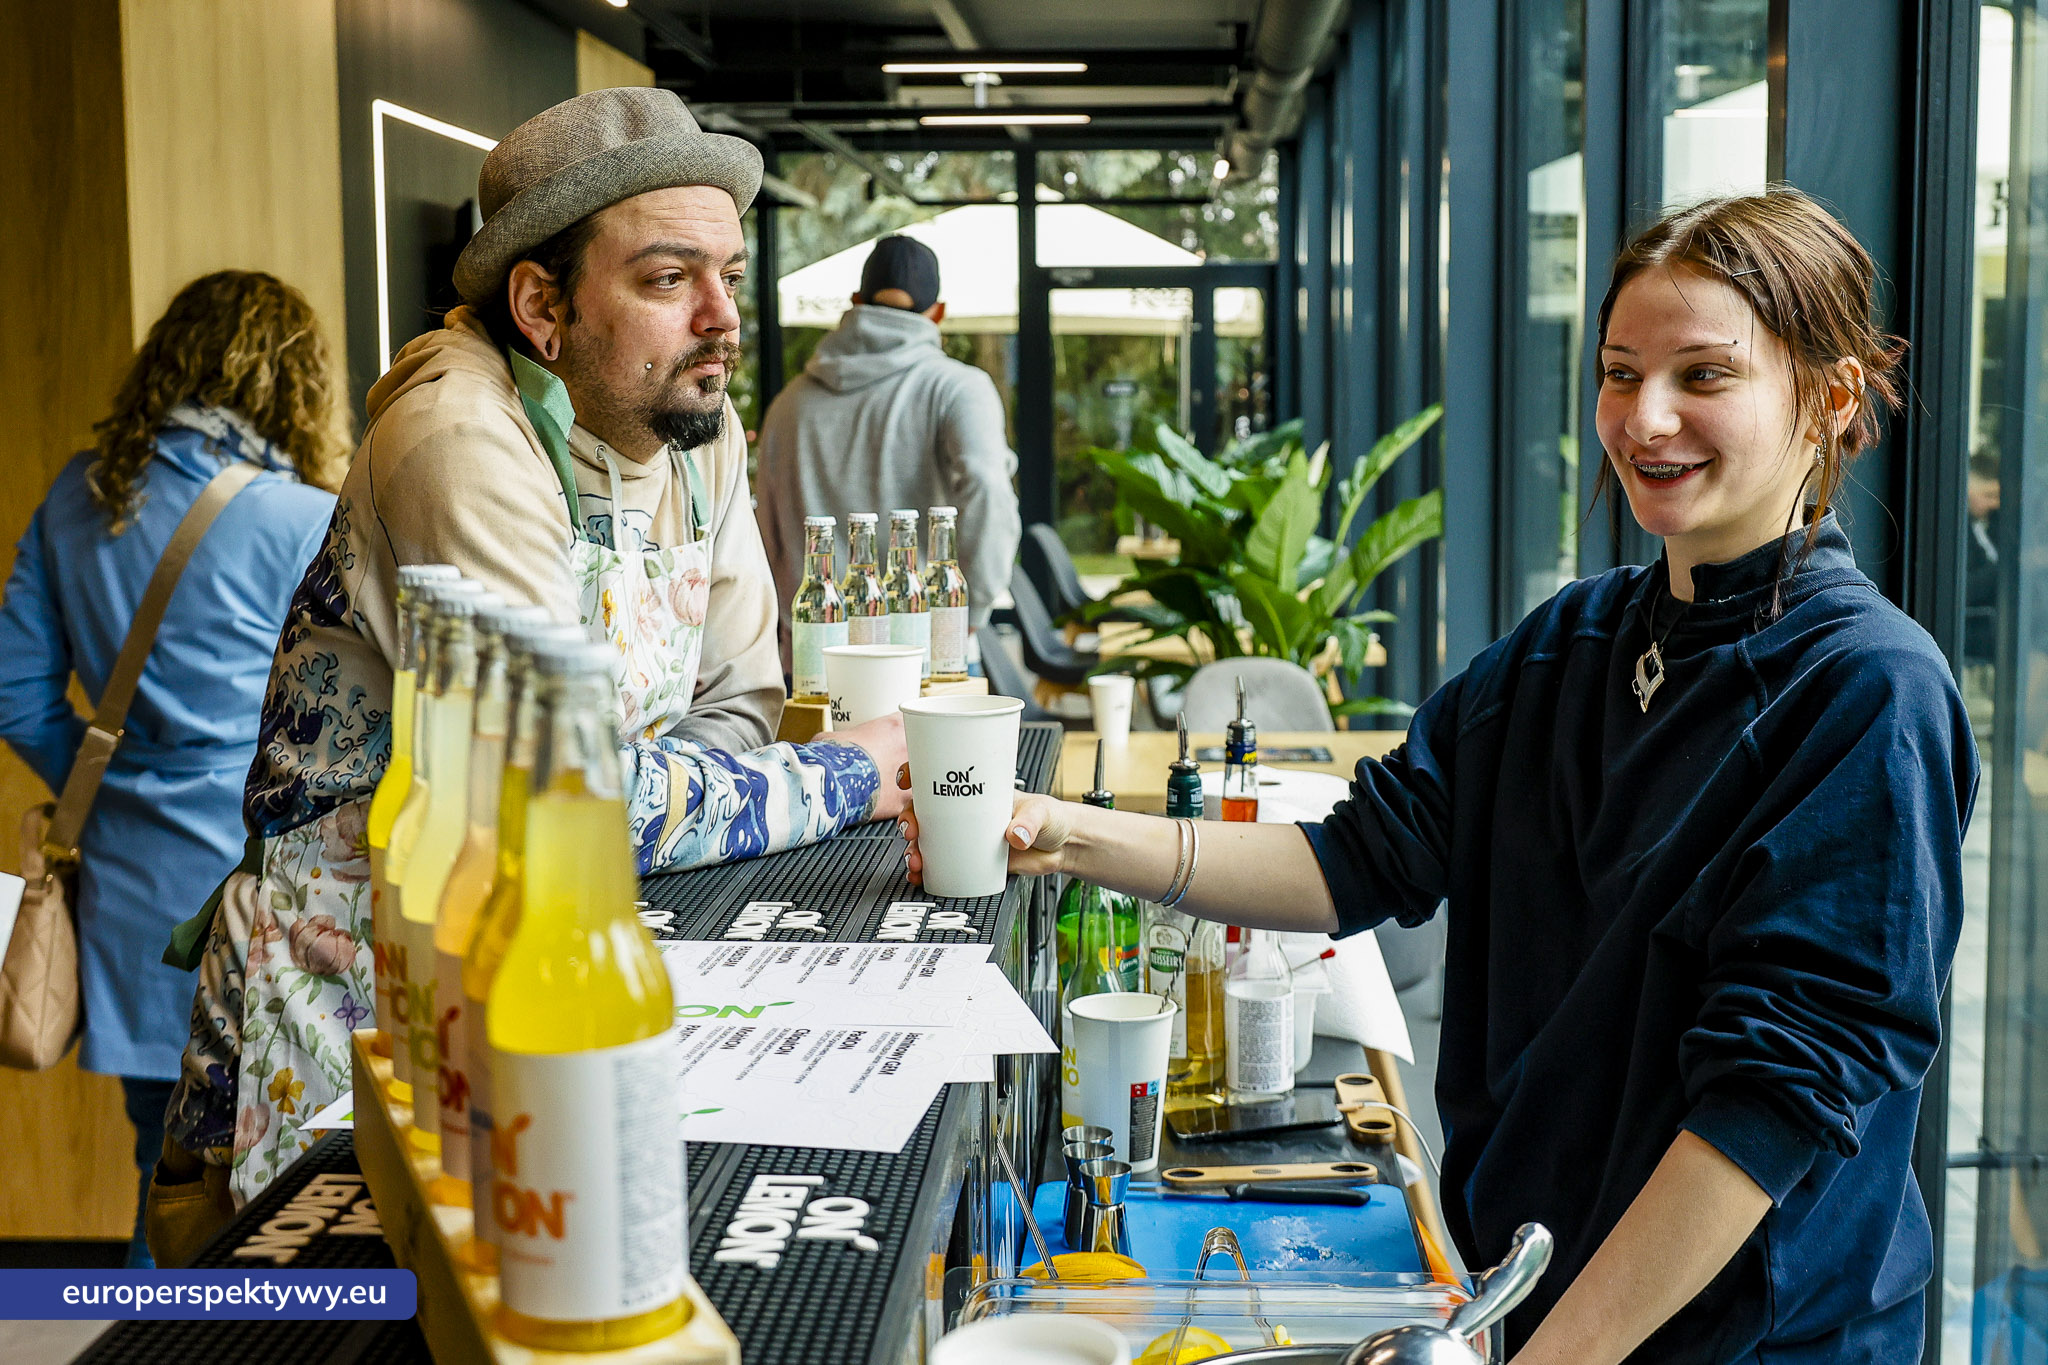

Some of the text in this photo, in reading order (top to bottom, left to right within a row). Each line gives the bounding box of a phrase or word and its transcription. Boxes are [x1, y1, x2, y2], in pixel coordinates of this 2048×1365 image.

[933, 781, 983, 797] LEMON
[946, 770, 970, 783] ON
[724, 900, 793, 941] LEMON
[775, 910, 824, 932] ON
[877, 901, 937, 941] LEMON
[926, 910, 971, 932] ON
[878, 1060, 902, 1076] GEM
[233, 1173, 364, 1260] LEMON
[713, 1174, 825, 1266] LEMON
[796, 1196, 871, 1241] ON
